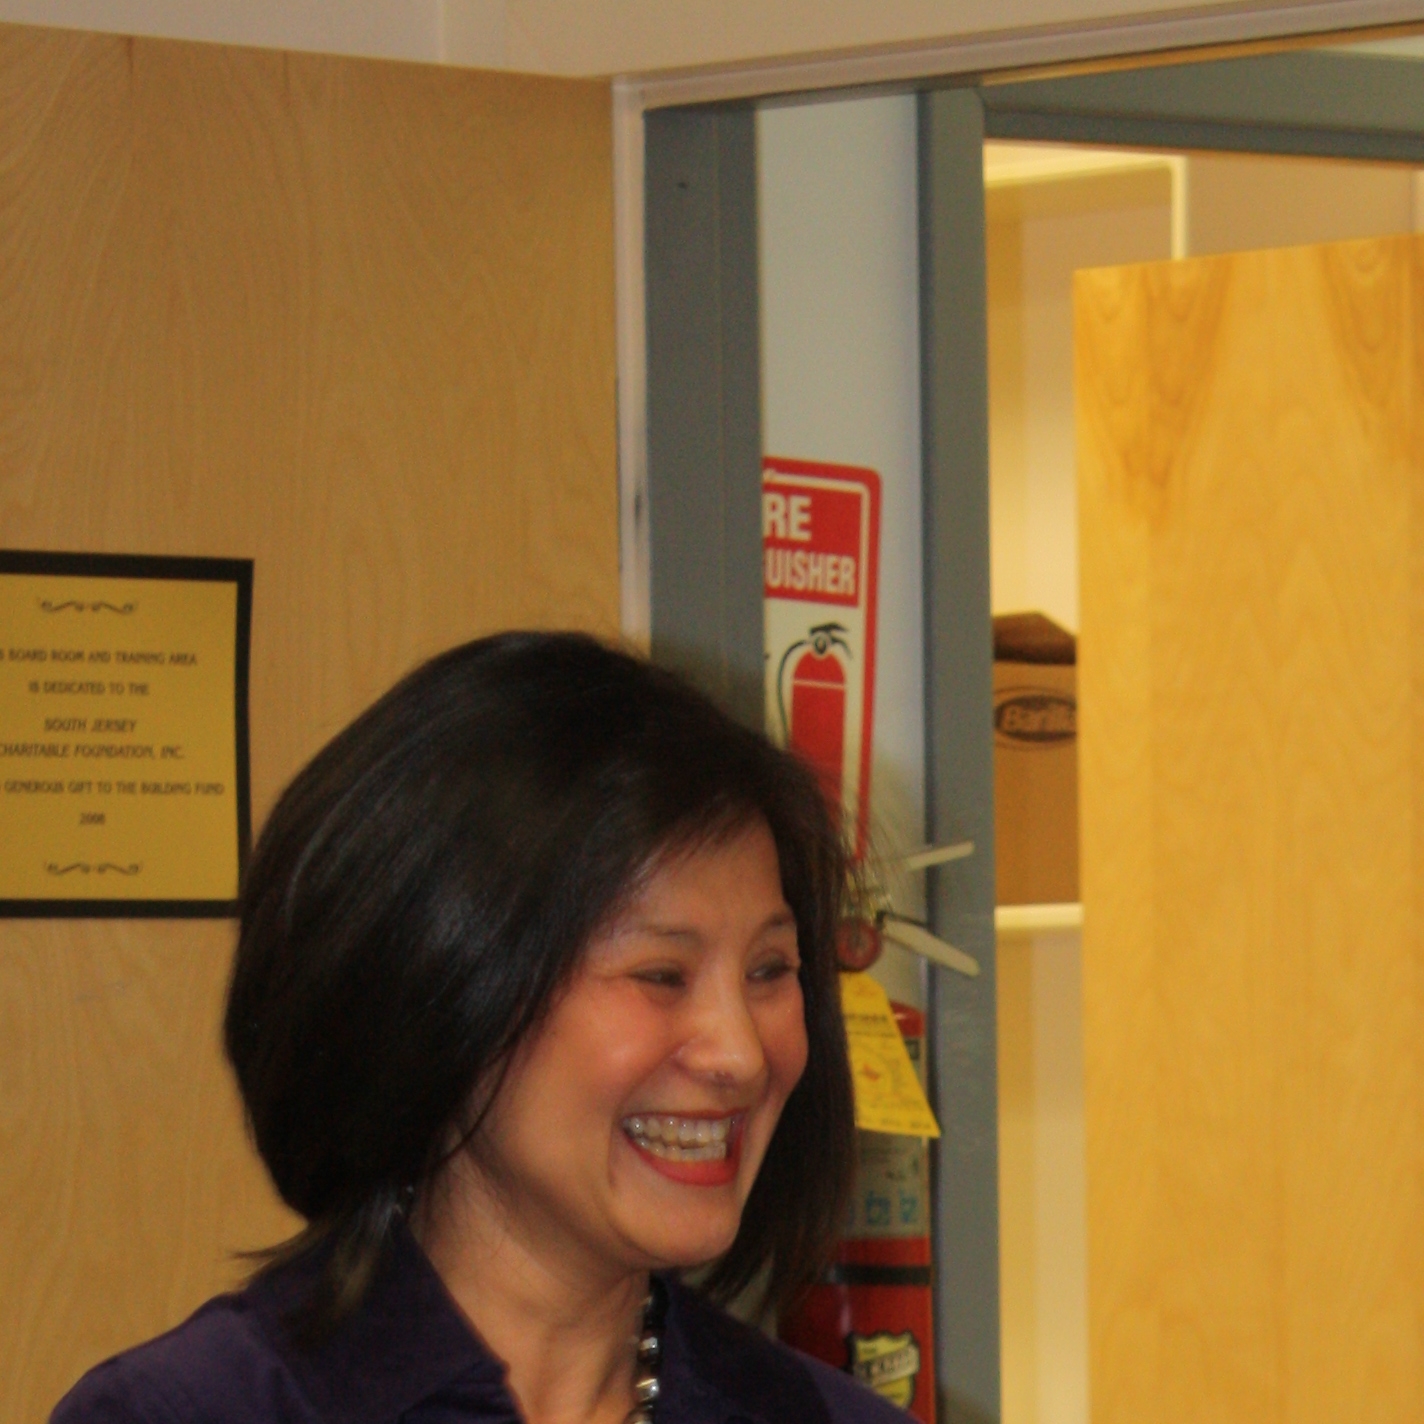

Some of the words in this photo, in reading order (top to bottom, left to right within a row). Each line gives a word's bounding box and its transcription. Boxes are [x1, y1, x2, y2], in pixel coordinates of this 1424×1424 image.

[762, 492, 812, 541] RE
[9, 648, 47, 661] BOARD
[52, 649, 84, 662] ROOM
[88, 650, 111, 663] AND
[115, 651, 165, 665] TRAINING
[169, 653, 198, 666] AREA
[44, 681, 105, 695] DEDICATED
[109, 682, 125, 695] TO
[129, 682, 149, 696] THE
[45, 718, 87, 732] SOUTH
[91, 719, 137, 733] JERSEY
[4, 780, 64, 794] GENEROUS
[68, 781, 93, 795] GIFT
[97, 781, 112, 795] TO
[116, 781, 136, 795] THE
[141, 782, 191, 796] BUILDING
[195, 782, 225, 796] FUND
